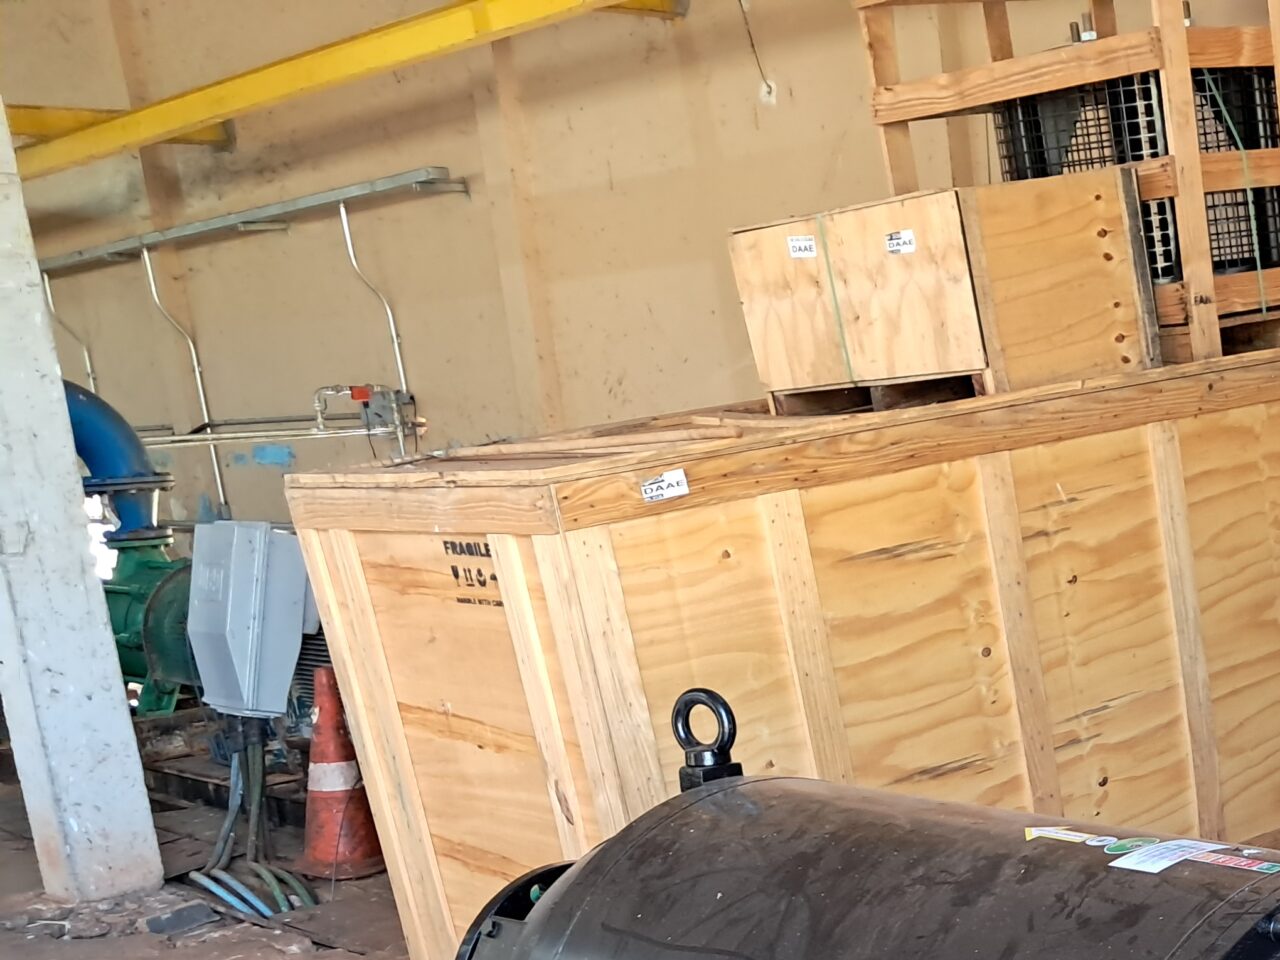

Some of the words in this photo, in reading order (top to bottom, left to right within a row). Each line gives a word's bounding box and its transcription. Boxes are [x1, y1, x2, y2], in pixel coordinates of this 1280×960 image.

[791, 244, 815, 253] DAAE
[888, 239, 914, 249] DAAE
[643, 479, 686, 495] DAAE
